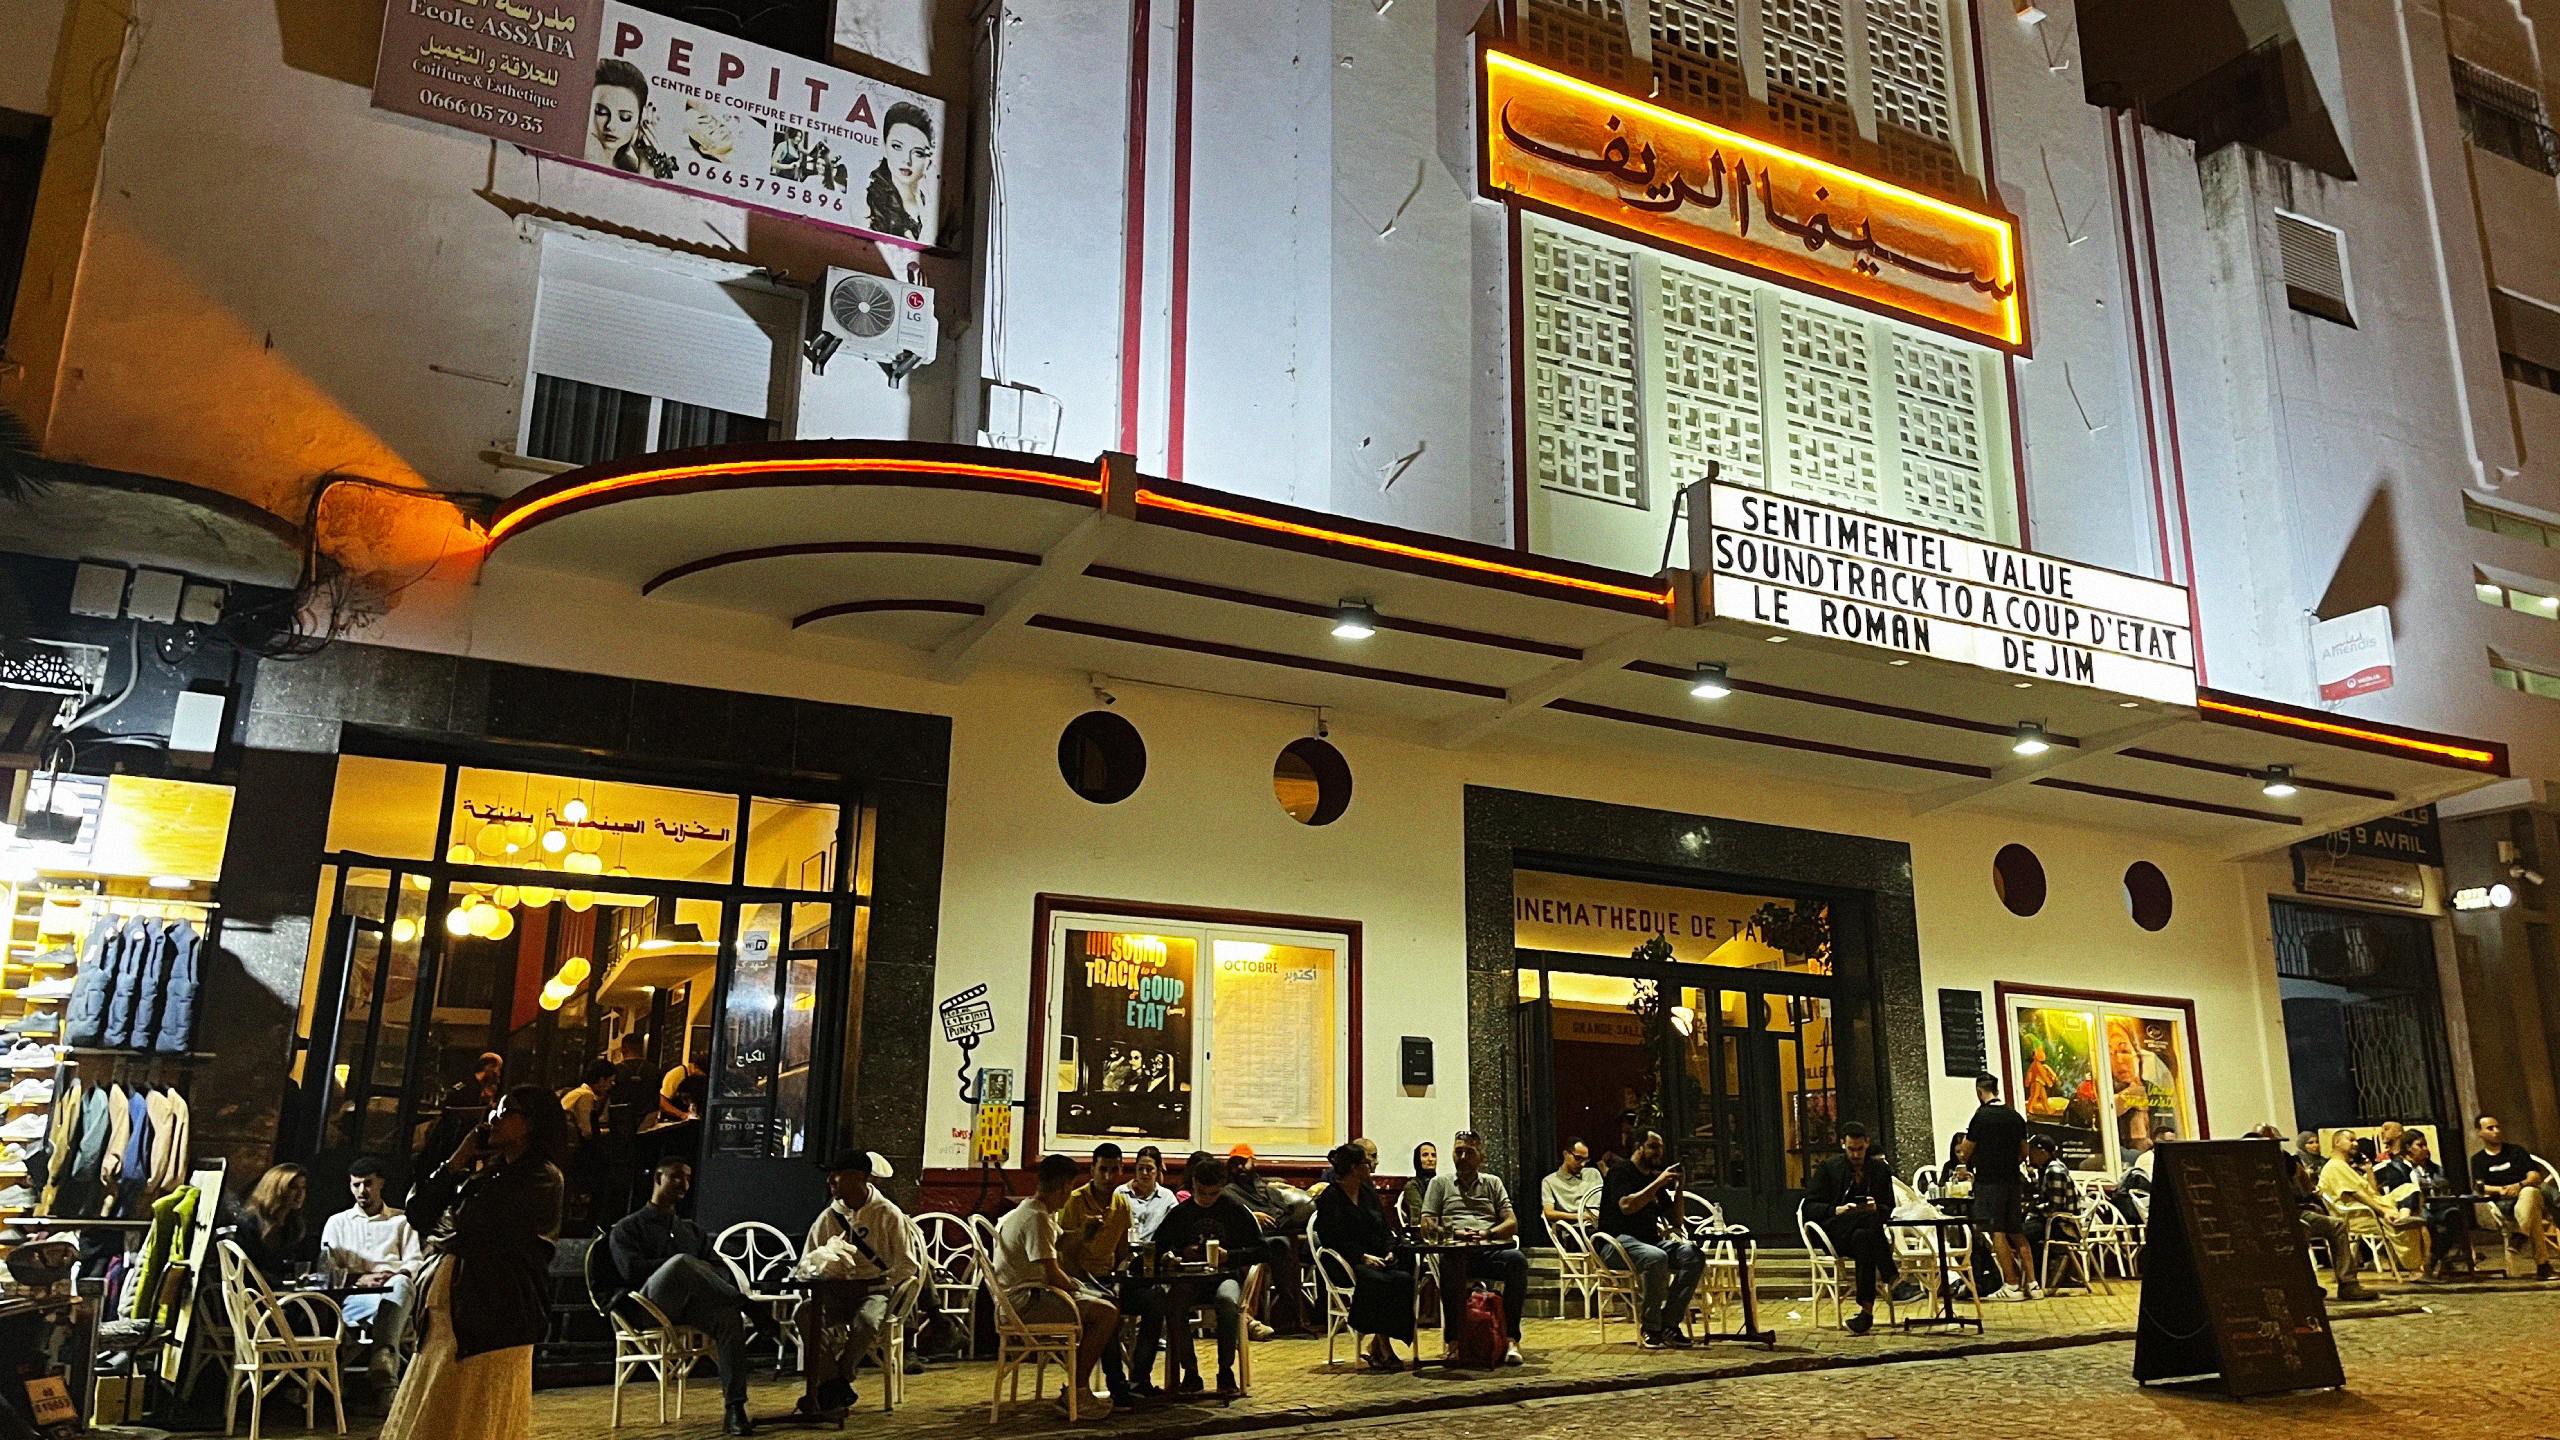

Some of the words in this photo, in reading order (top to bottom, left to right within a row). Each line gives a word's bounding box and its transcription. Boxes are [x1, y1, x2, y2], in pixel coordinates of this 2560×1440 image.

[419, 35, 486, 67] التجميل
[479, 17, 575, 60] ASSAFA
[412, 58, 472, 86] Coiffure
[473, 74, 483, 89] &
[486, 57, 495, 74] و
[500, 53, 559, 87] للحلاقة
[613, 21, 877, 130] PEPITA
[419, 88, 467, 115] 0666
[470, 102, 494, 122] 05
[498, 108, 519, 127] 79
[520, 115, 544, 135] 33
[651, 75, 701, 98] CENTRE
[704, 89, 722, 104] DE
[724, 96, 786, 122] COIFFURE
[789, 113, 805, 127] ET
[1500, 95, 1754, 239] الريف
[687, 161, 844, 213] 0665795896
[1759, 164, 2016, 302] سينما
[907, 312, 921, 322] LG
[1741, 494, 1953, 575] SENTIMENTEL
[1982, 547, 2075, 600] VALUE
[1715, 533, 1931, 611] SOUNDTRACK
[1938, 581, 1974, 619] TO
[1983, 592, 1998, 625] A
[2006, 596, 2080, 640] COUP
[2090, 612, 2178, 662] D'ETAT
[1753, 584, 1791, 627] LE
[1820, 599, 1932, 654] ROMAN
[2002, 635, 2037, 674] DE
[2045, 645, 2096, 685] JIM
[654, 817, 731, 844] الخزانة
[2355, 827, 2368, 845] 9
[2374, 829, 2428, 855] AVRIL
[1516, 896, 1681, 937] INEMATHEQUE
[1691, 914, 1717, 940] DE
[1111, 933, 1168, 968] SOUND
[1223, 960, 1279, 974] OCTOBRE
[1085, 958, 1141, 990] TRACK
[1139, 974, 1185, 1006] COUP
[1283, 963, 1317, 984] أكتوبر
[1126, 1000, 1167, 1031] ETAT
